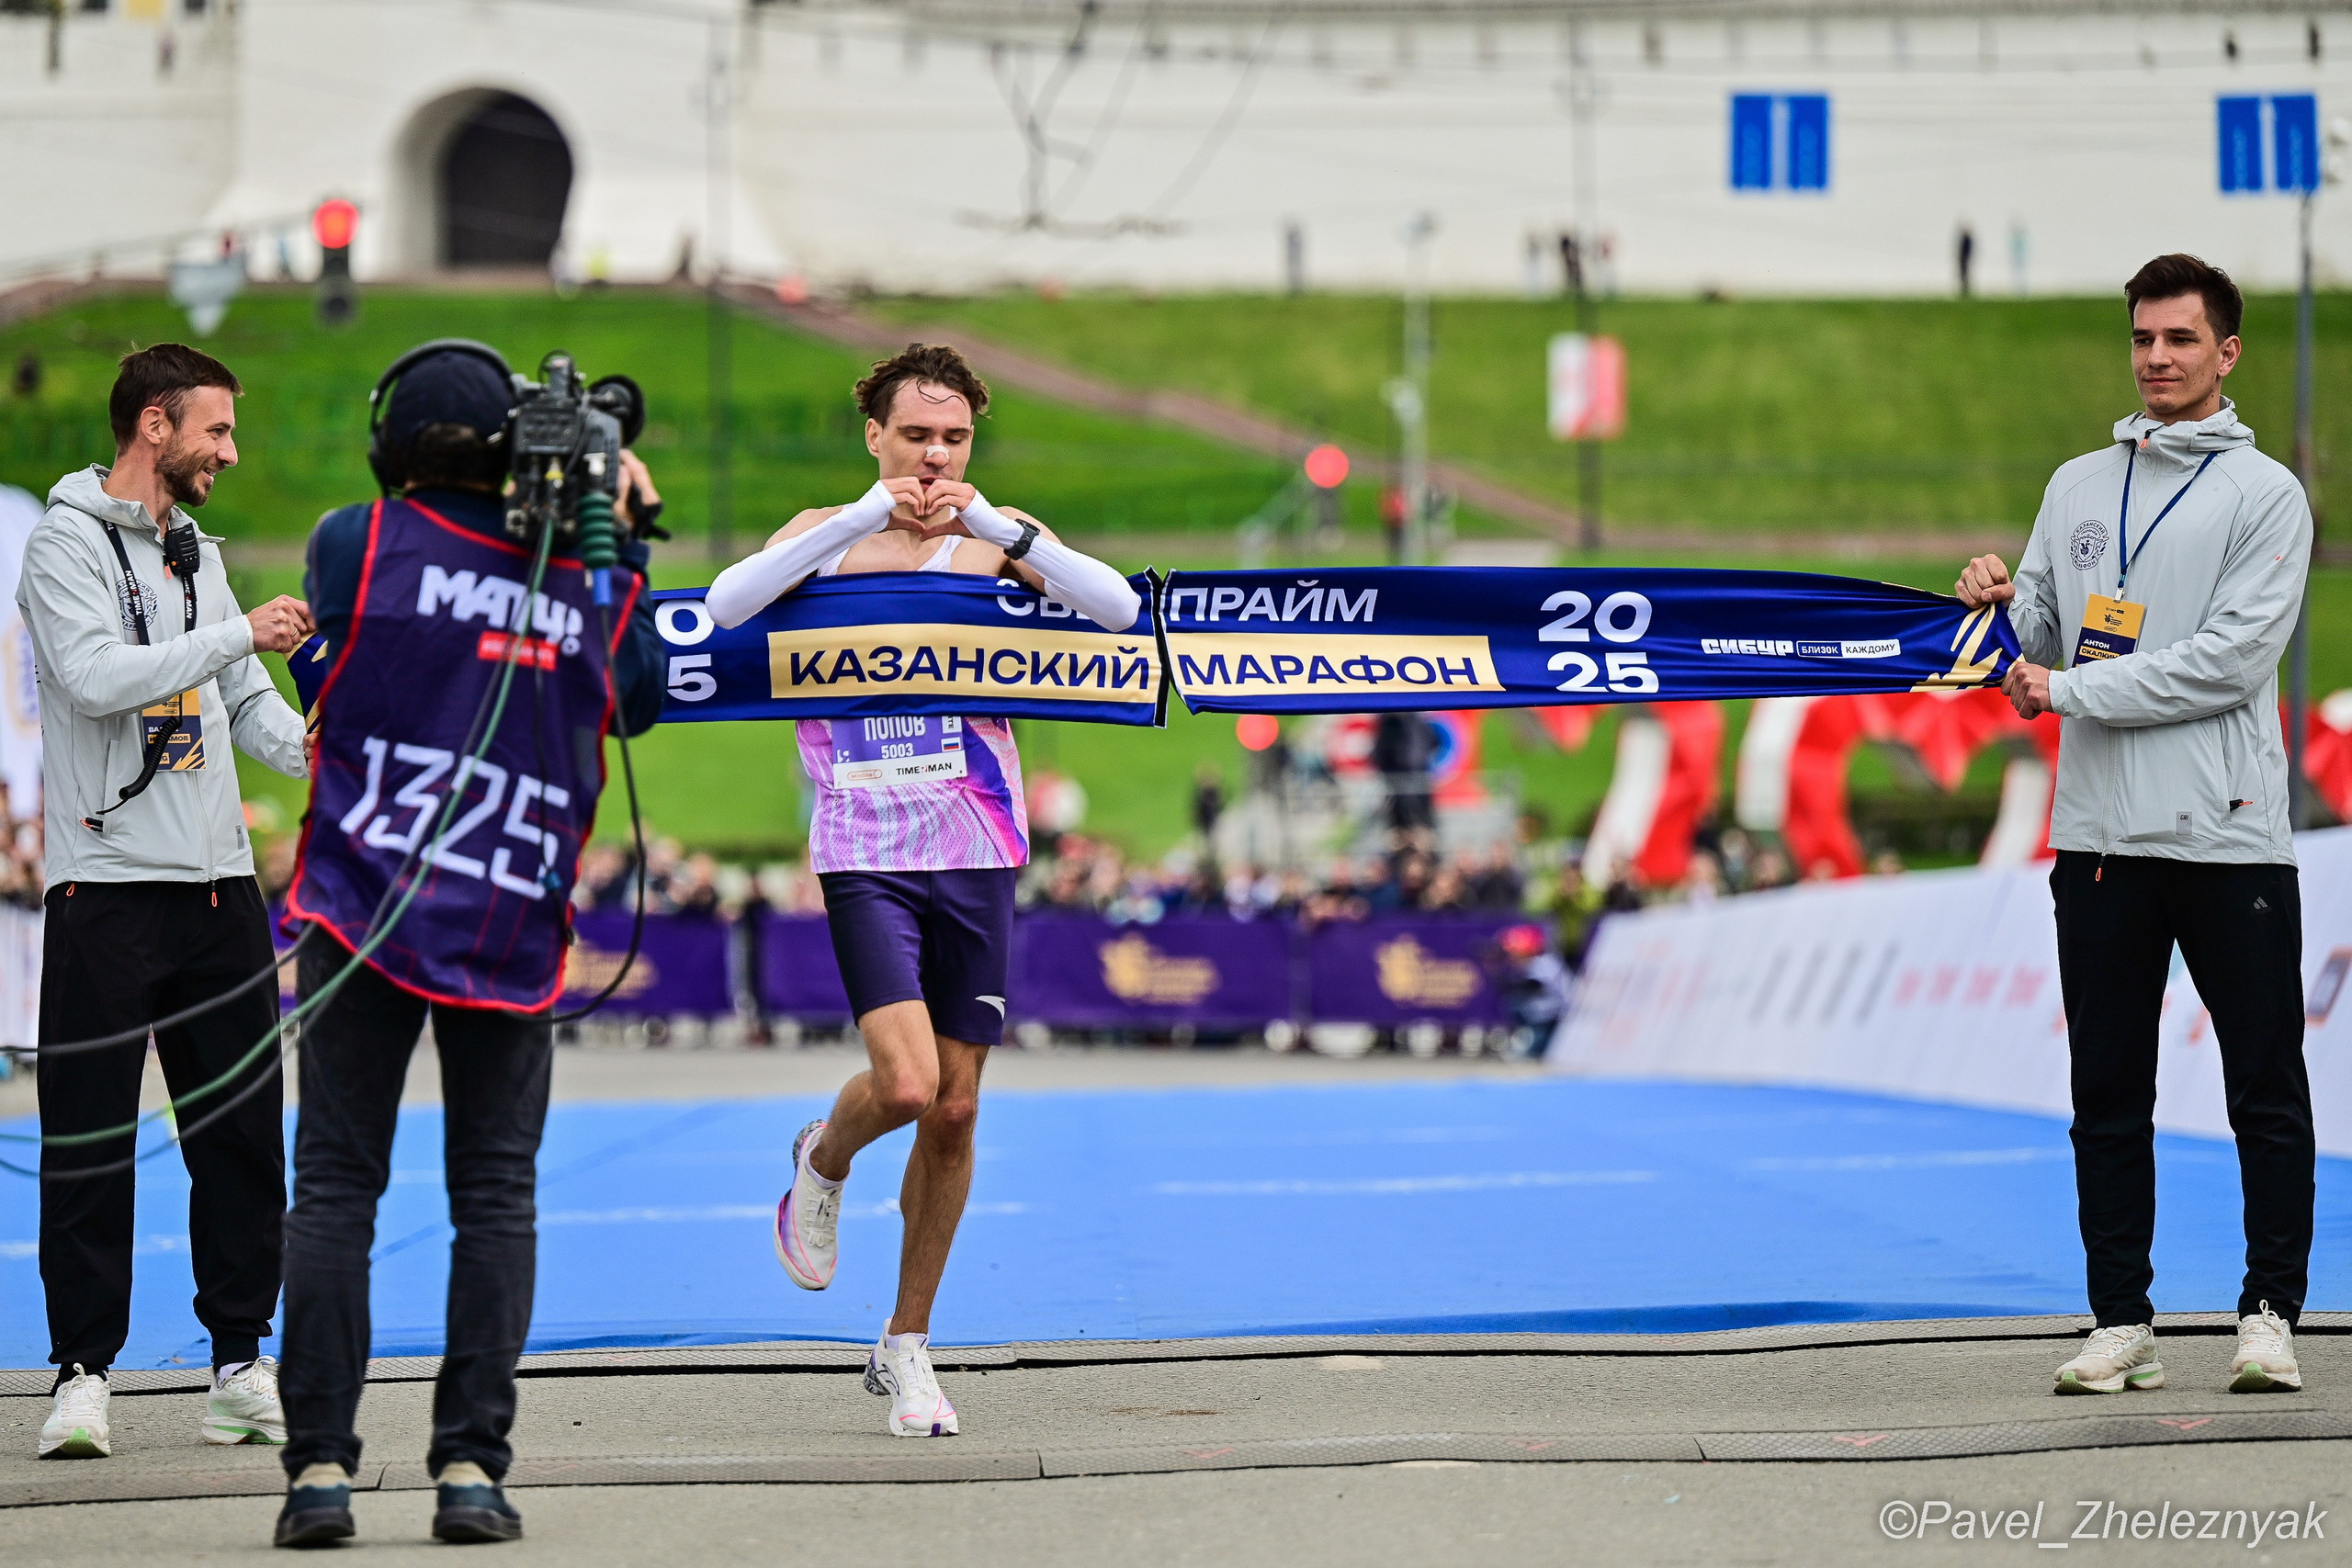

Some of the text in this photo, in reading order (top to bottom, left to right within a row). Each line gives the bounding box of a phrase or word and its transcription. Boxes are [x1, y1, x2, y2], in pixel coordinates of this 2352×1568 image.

[1169, 580, 1378, 622] ПРАЙМ
[1538, 591, 1653, 643] 20
[1701, 638, 1896, 657] СИБУР БЛИЗОК КАЖДОМУ
[2083, 638, 2110, 649] АНТОН
[790, 646, 1477, 690] КАЗАНСКИЙ МАРАФОН
[1547, 651, 1660, 694] 25
[864, 716, 926, 741] ПОПОВ
[880, 742, 914, 760] 5003
[339, 737, 570, 900] 1325
